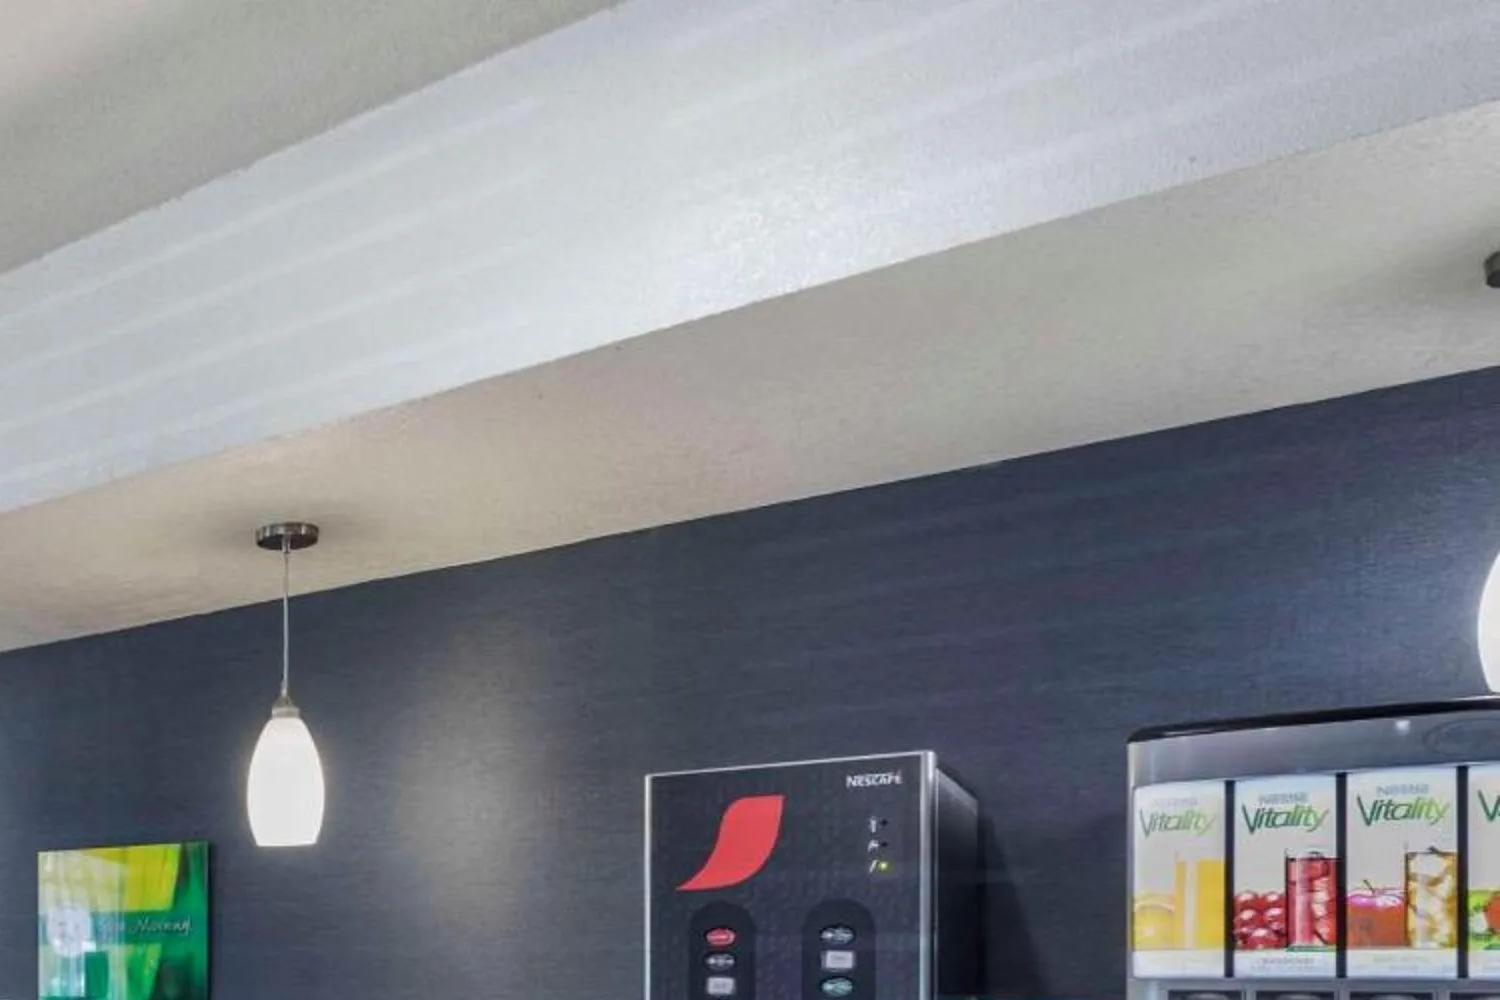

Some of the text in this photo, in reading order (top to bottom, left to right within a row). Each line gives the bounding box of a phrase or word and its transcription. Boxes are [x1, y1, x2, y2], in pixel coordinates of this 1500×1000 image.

[1139, 808, 1217, 839] Vitality
[1241, 802, 1330, 835] Vitality
[1357, 794, 1451, 827] Vitality
